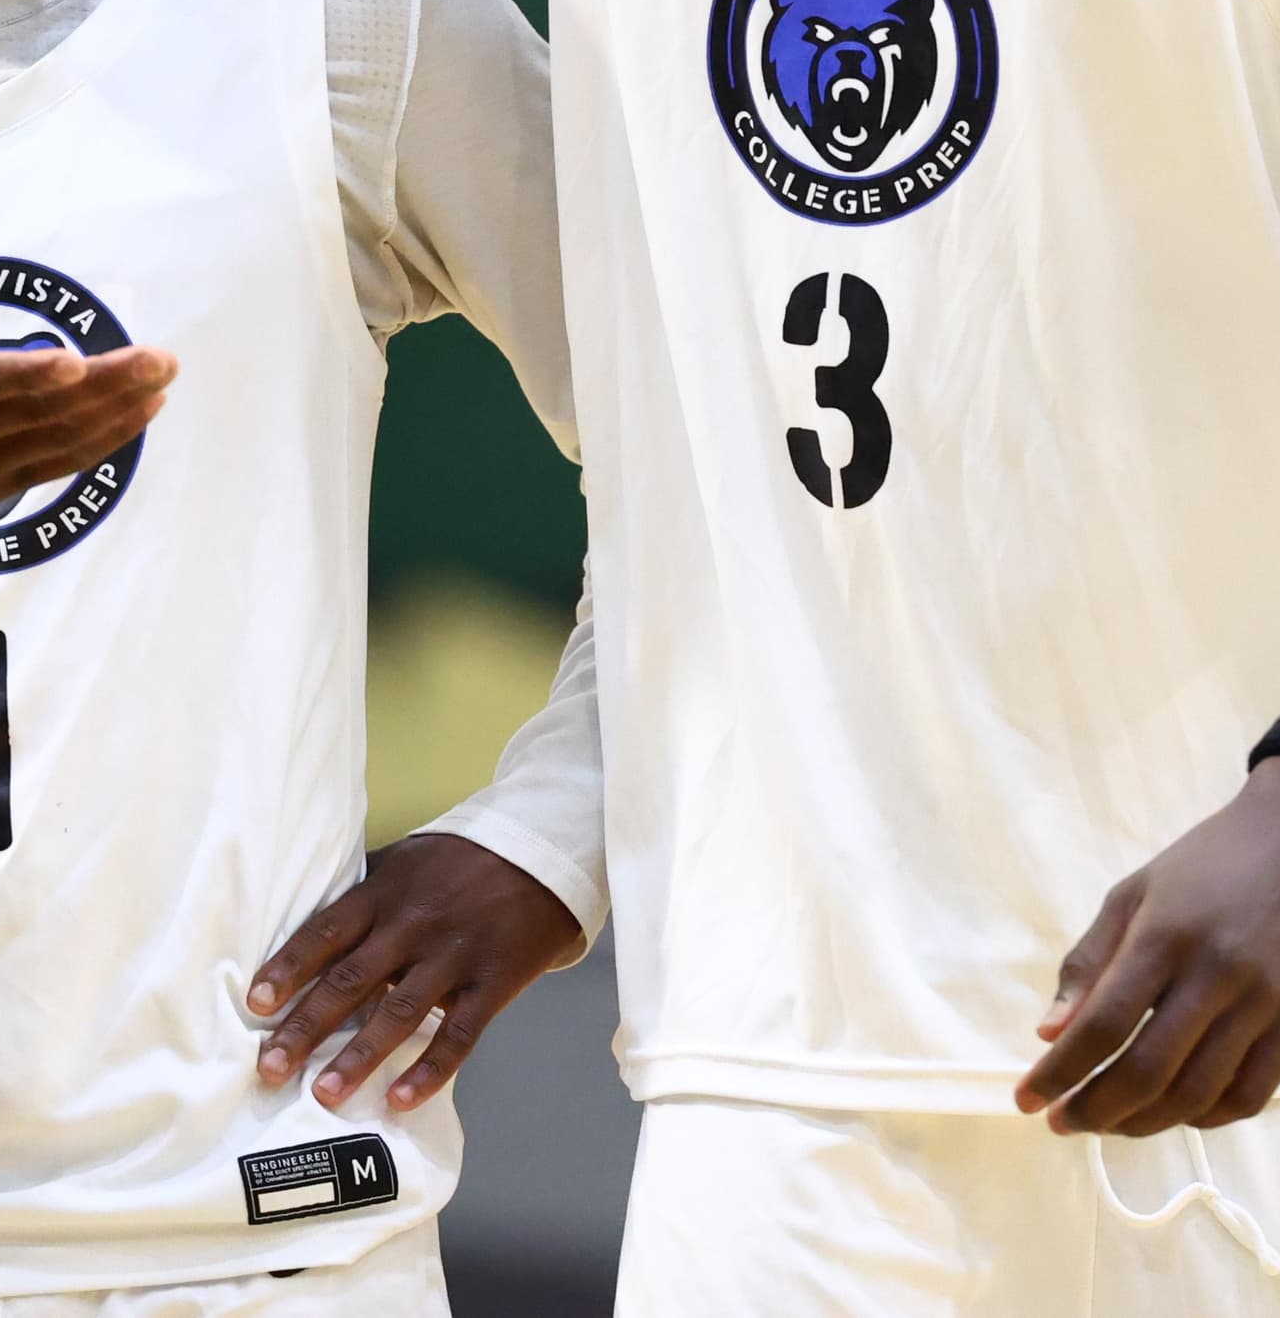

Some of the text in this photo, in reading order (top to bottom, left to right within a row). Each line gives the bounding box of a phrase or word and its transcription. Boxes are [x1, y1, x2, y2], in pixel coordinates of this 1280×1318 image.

[734, 110, 971, 215] COLLEGE PREP
[782, 272, 892, 510] 3
[35, 462, 116, 550] PREP
[251, 1151, 329, 1172] ENGINEERED
[351, 1155, 377, 1186] M
